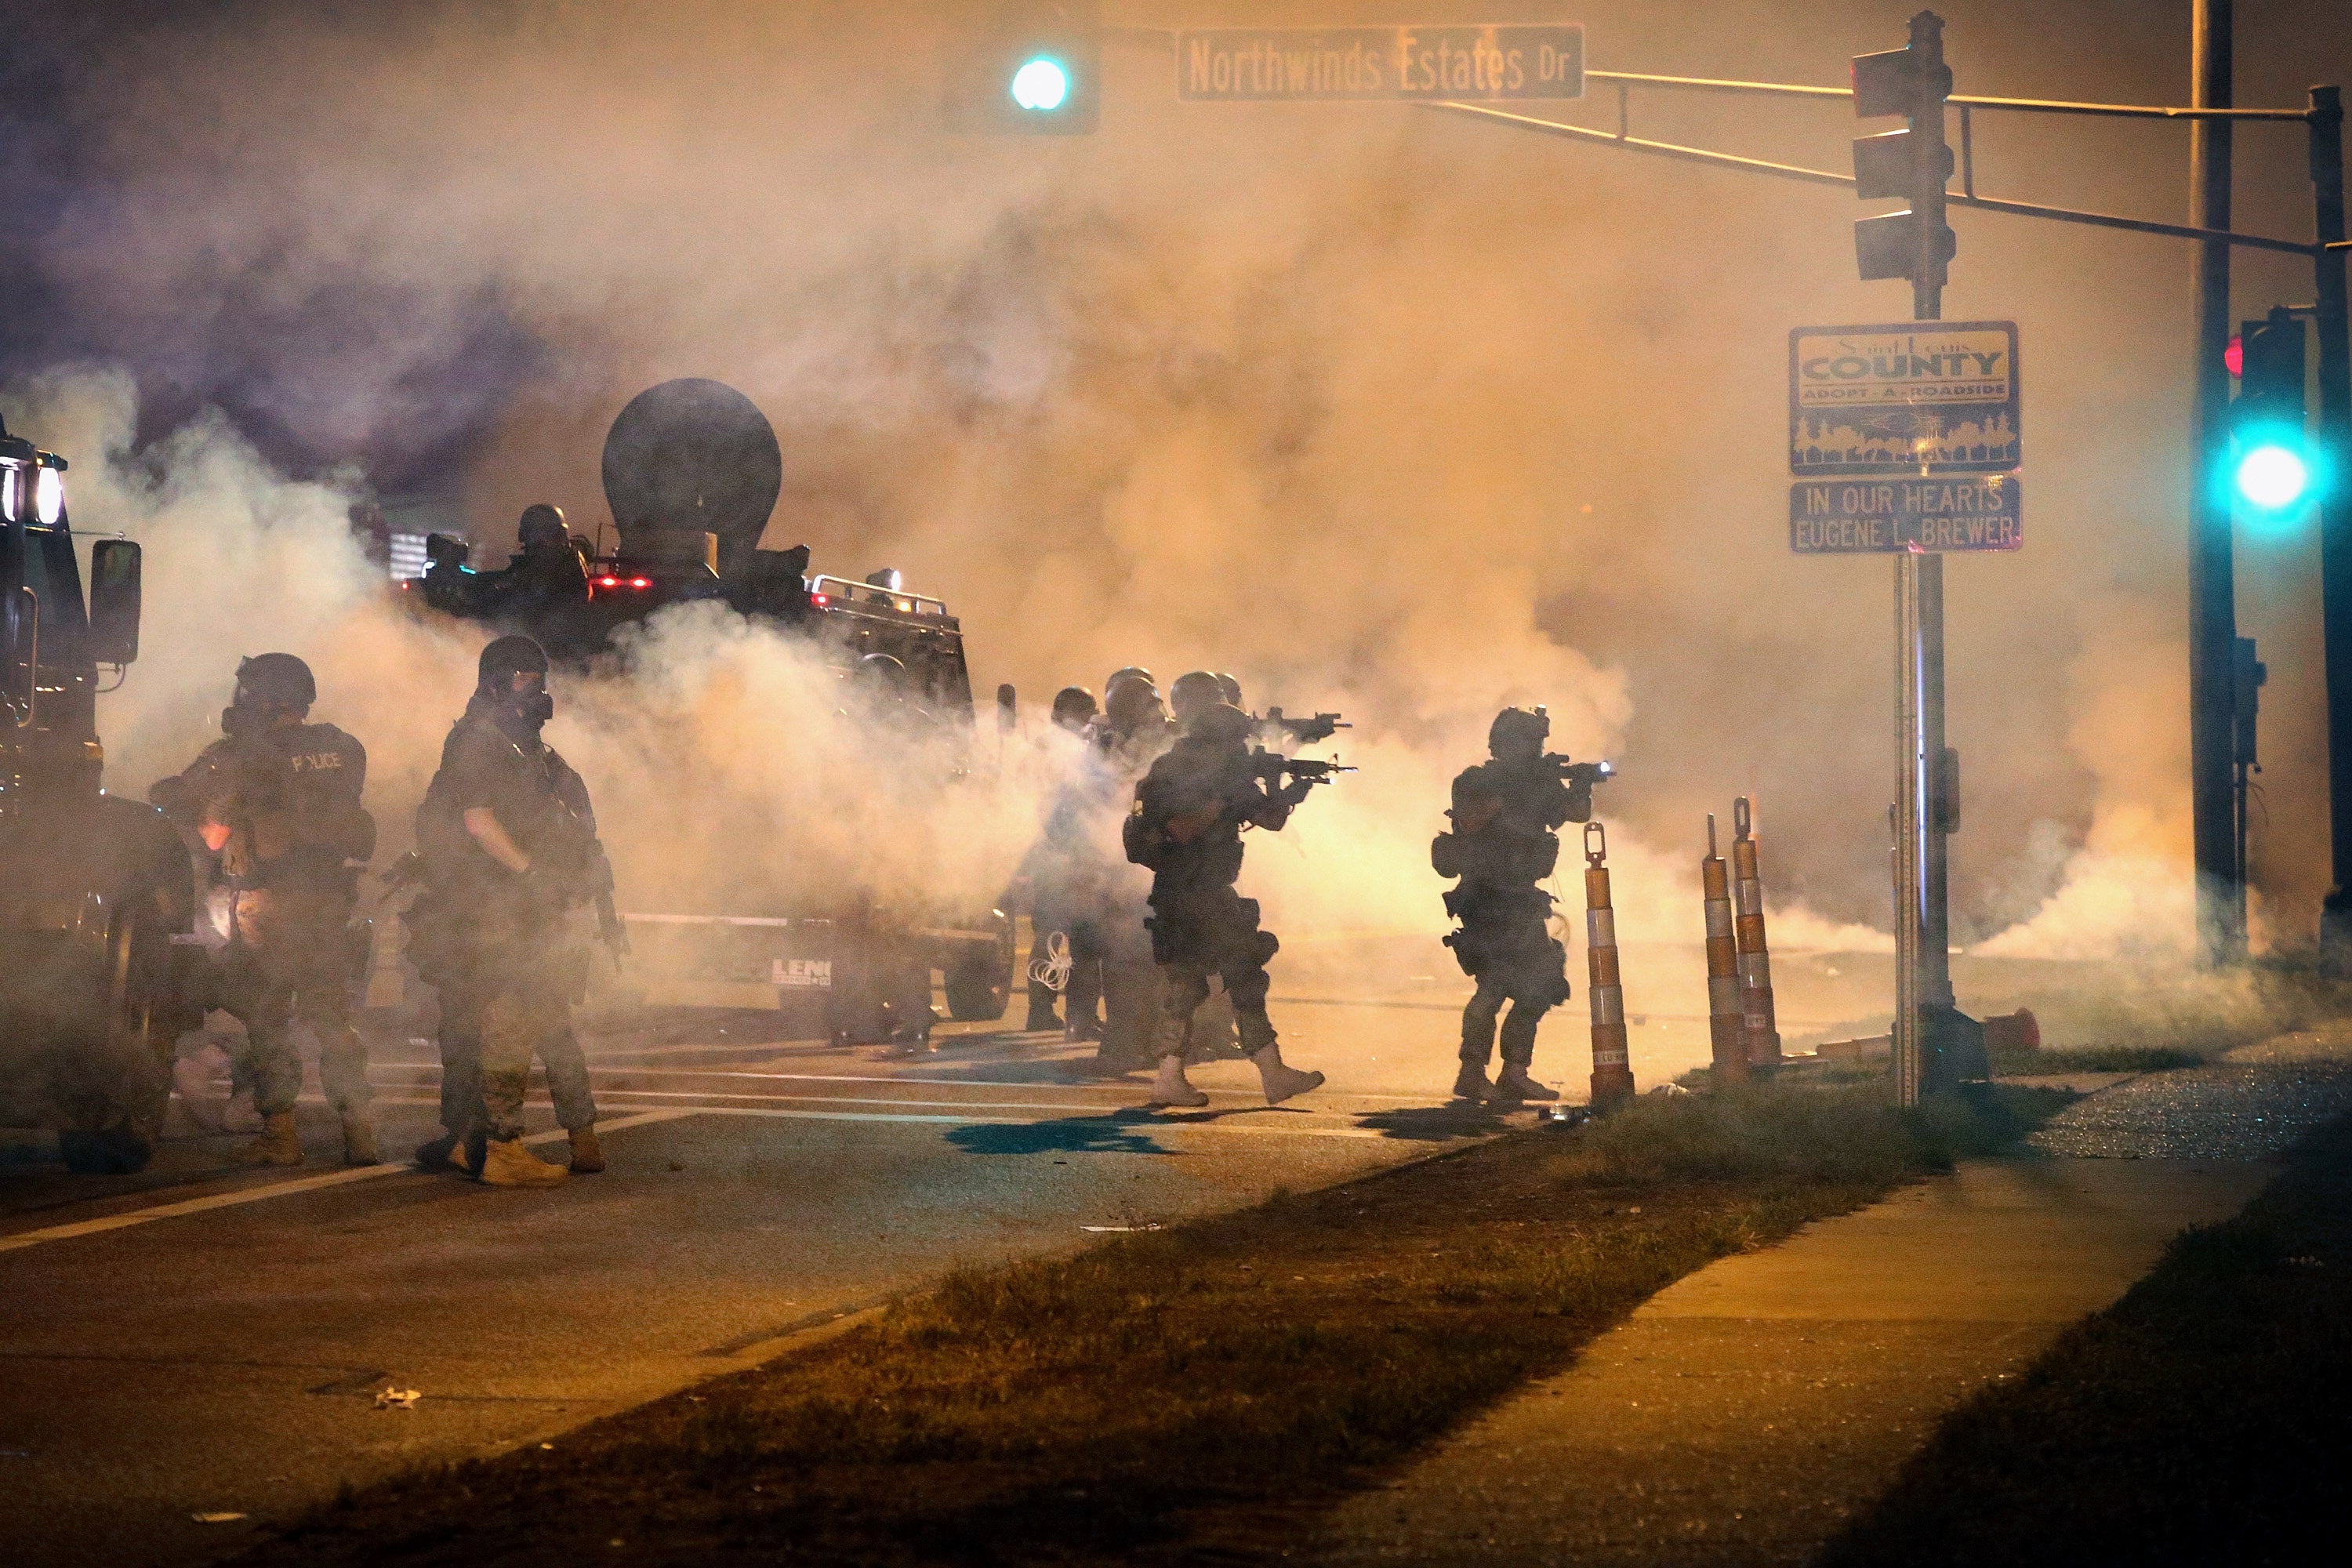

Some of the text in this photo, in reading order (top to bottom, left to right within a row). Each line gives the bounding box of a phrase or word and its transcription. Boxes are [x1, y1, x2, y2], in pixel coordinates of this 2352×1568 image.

[1189, 36, 1571, 93] Northwinds Estates Dr
[1802, 352, 2003, 380] COUNTY
[1806, 483, 2003, 515] IN OUR HEARTS
[1795, 519, 1882, 548] EUGENE
[1922, 517, 2014, 545] BREWER
